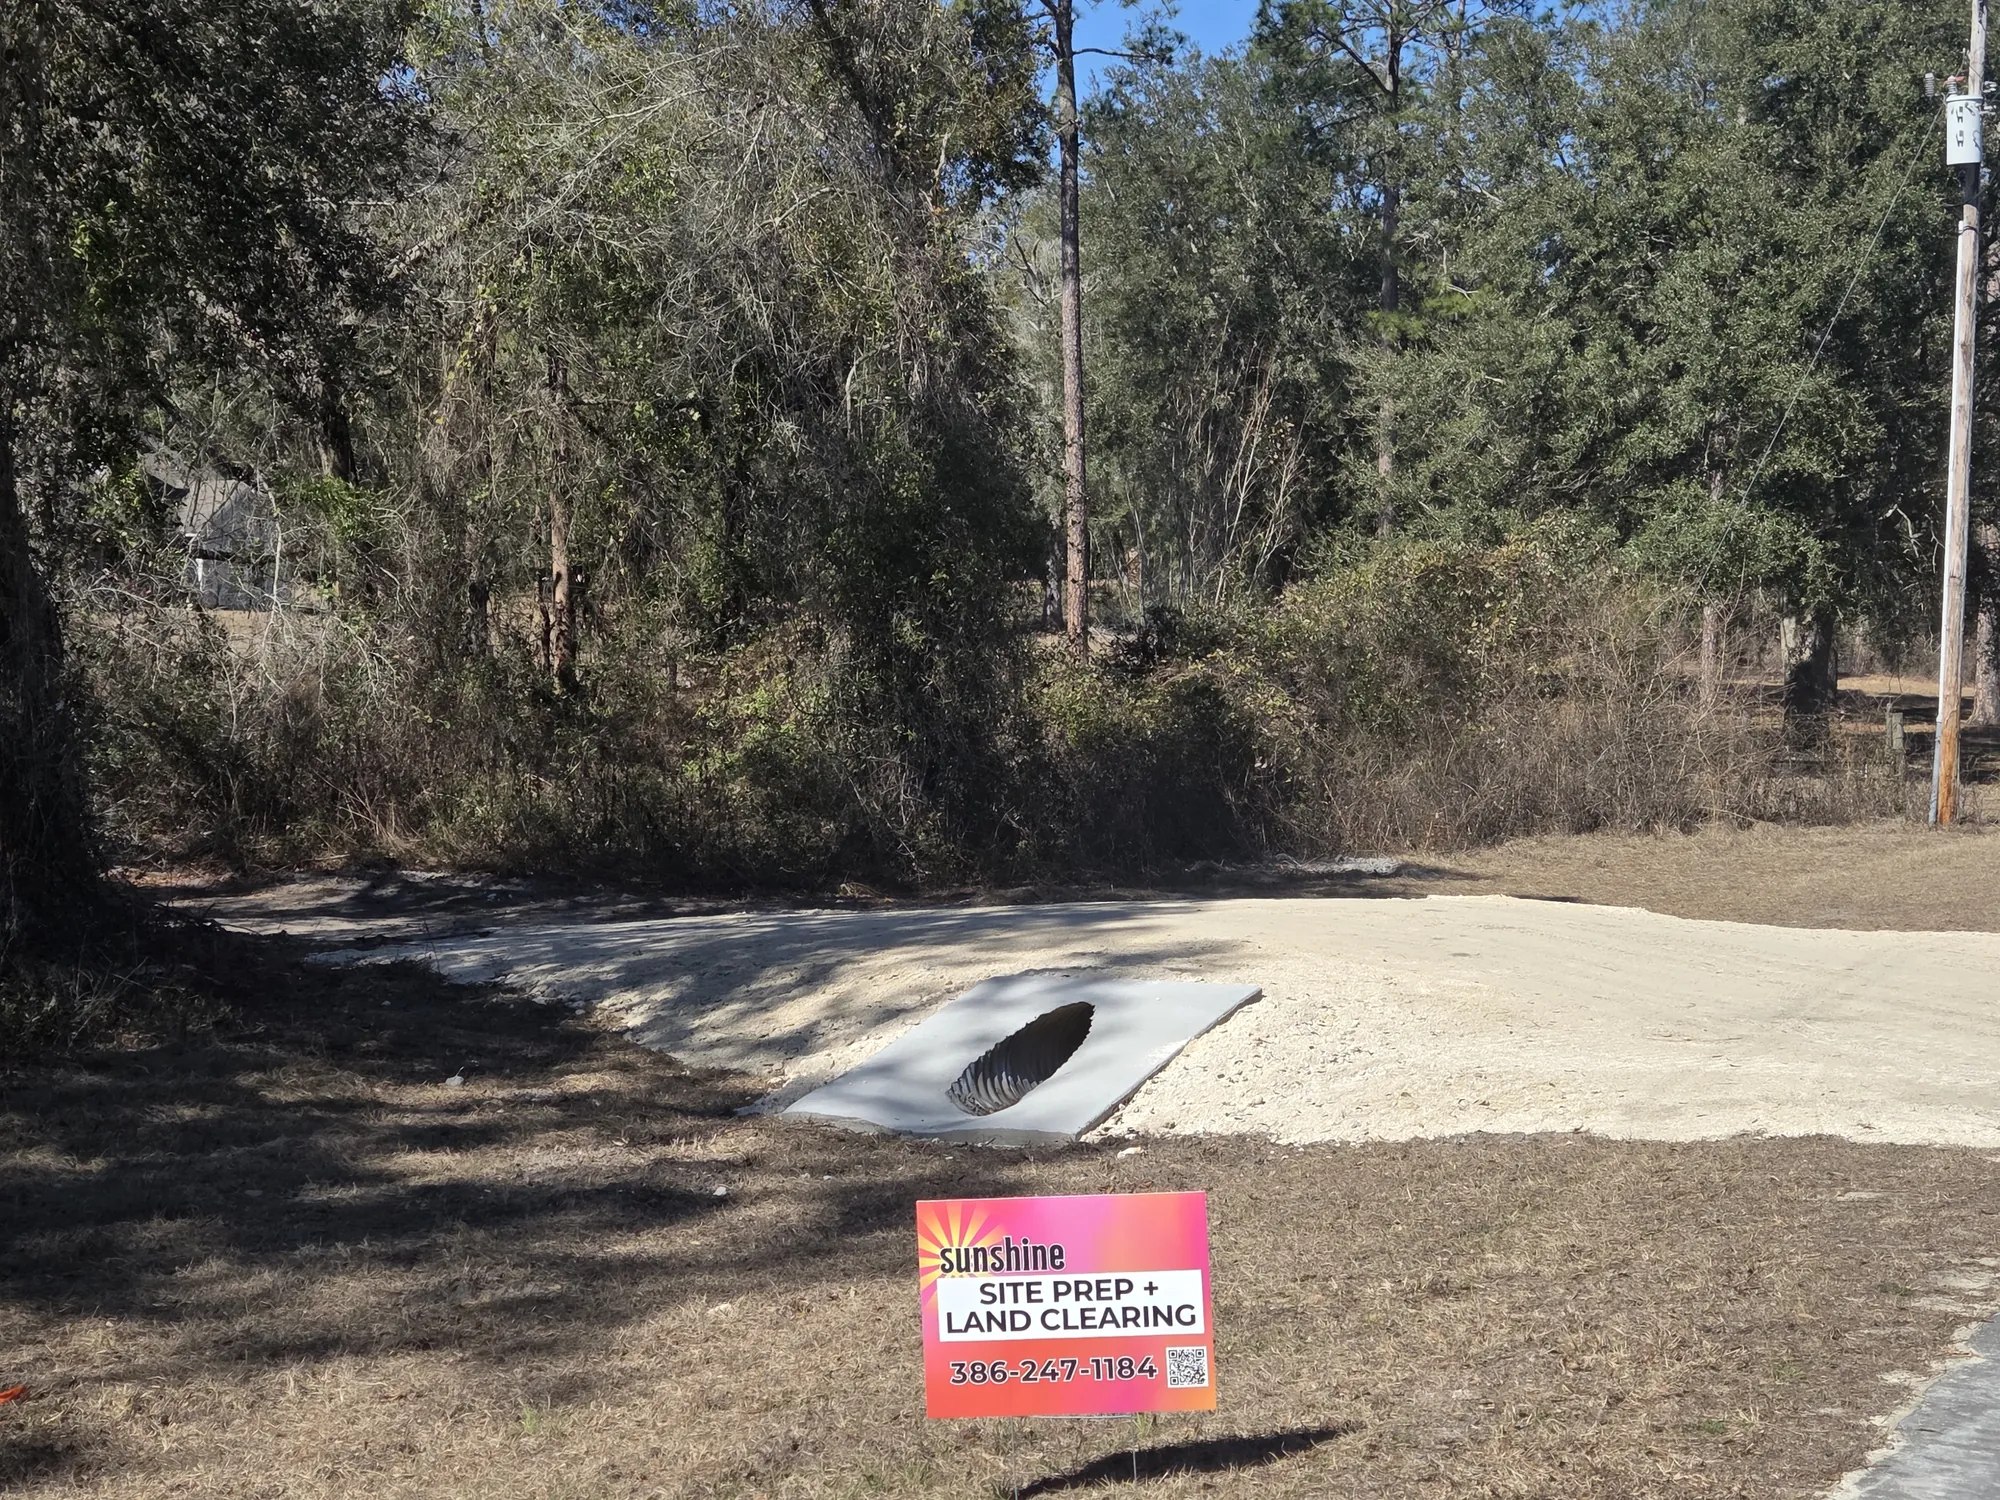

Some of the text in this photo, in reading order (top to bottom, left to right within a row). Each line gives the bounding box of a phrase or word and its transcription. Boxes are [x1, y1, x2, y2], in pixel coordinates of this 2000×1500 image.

[940, 1237, 1065, 1273] sunshine
[979, 1278, 1159, 1305] SITE PREP +
[946, 1304, 1196, 1334] LAND CLEARING
[950, 1356, 1158, 1385] 386-247-1184
